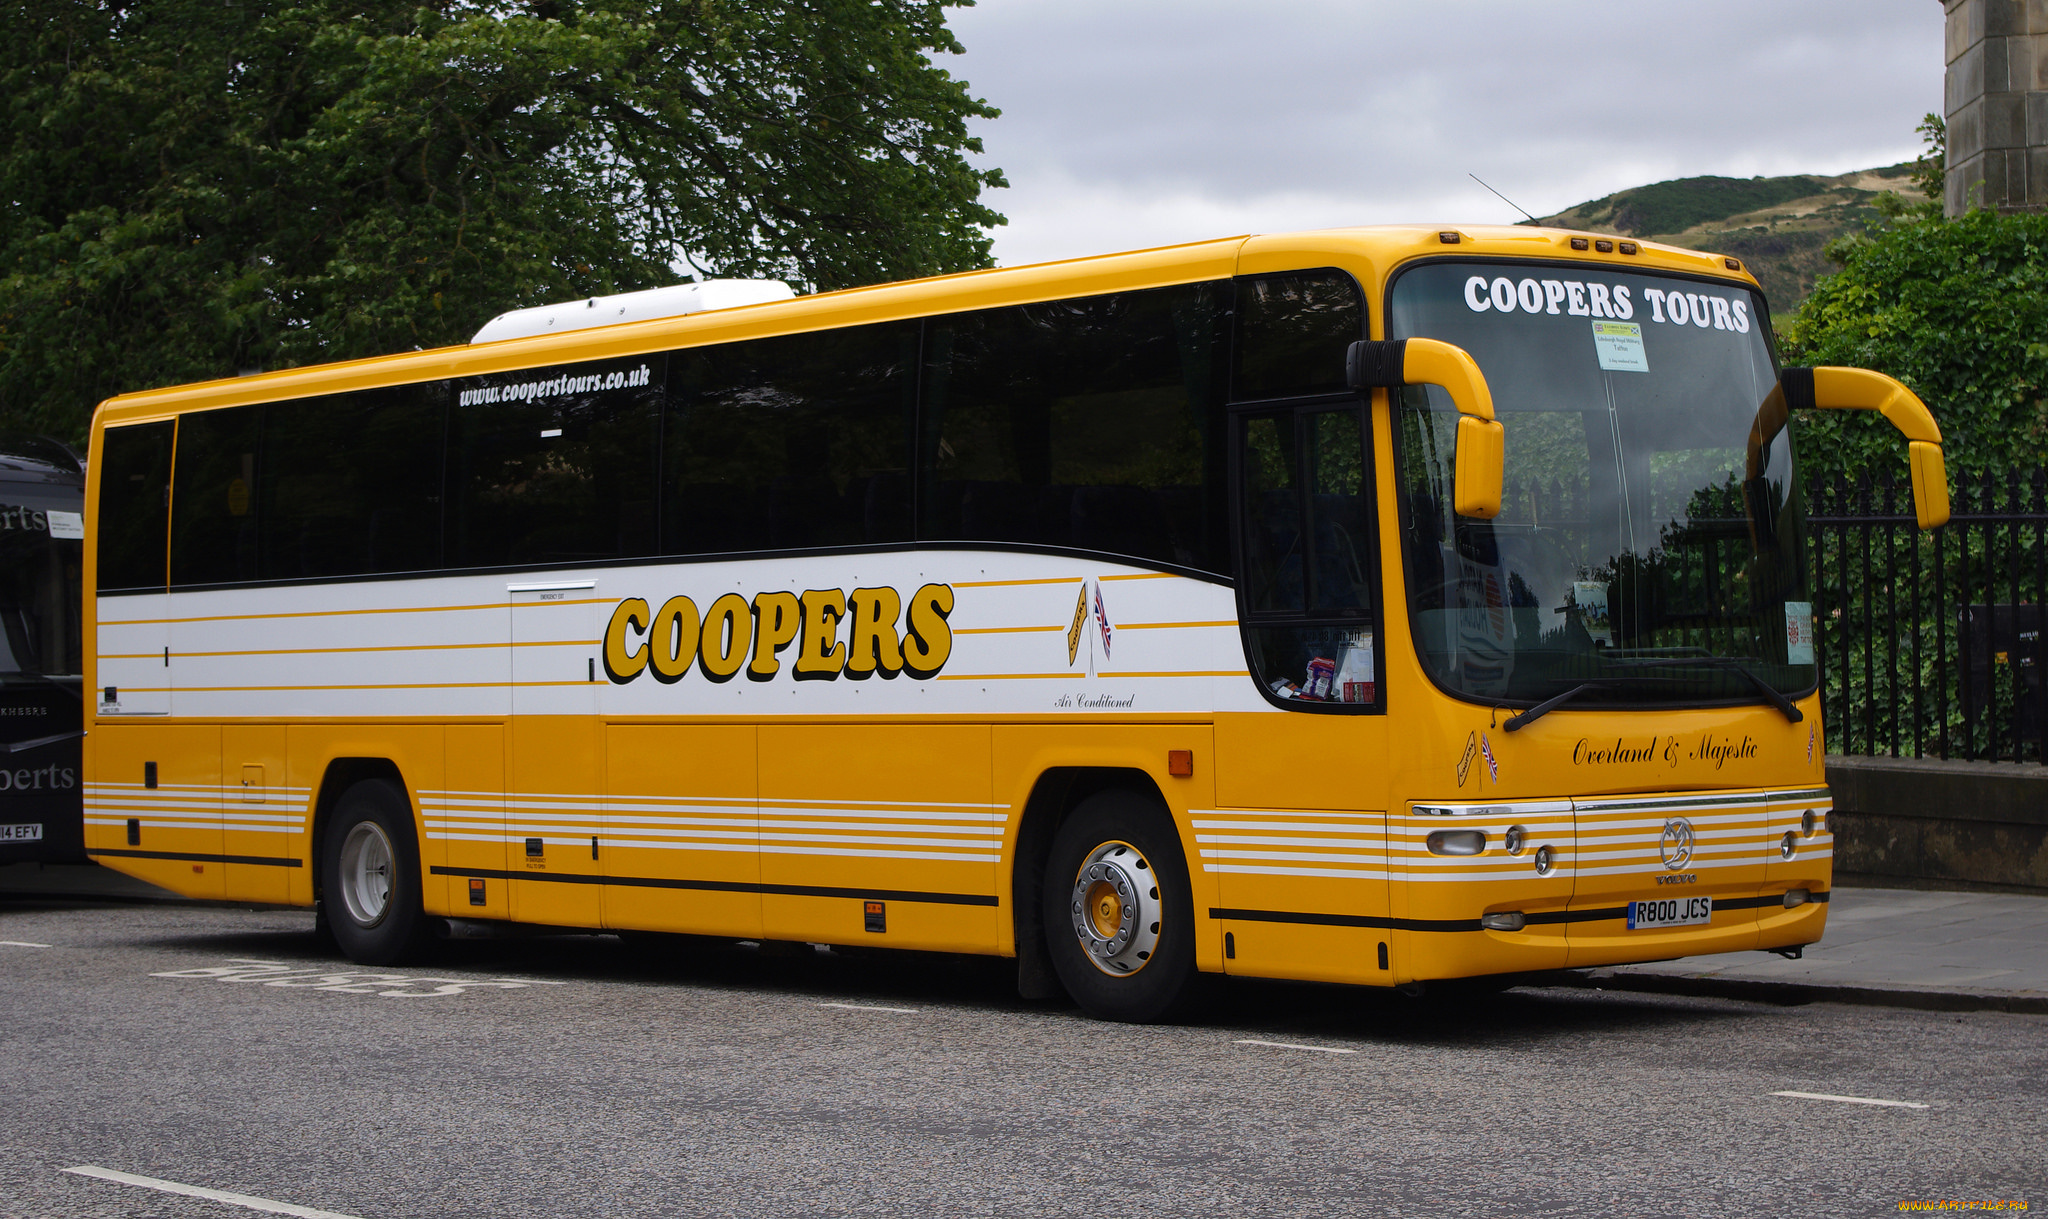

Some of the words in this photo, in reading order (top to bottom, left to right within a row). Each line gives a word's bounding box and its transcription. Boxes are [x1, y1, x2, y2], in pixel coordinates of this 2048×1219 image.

[1464, 276, 1633, 320] COOPERS
[1644, 288, 1750, 334] TOURS
[459, 364, 650, 407] www.cooperstours.co.uk
[0, 505, 48, 531] rts
[603, 583, 955, 685] COOPERS
[1054, 693, 1071, 708] Air
[1076, 692, 1135, 708] Conditioned
[1573, 736, 1657, 765] Overland
[1663, 736, 1679, 768] &
[1689, 734, 1757, 770] Majestic
[0, 826, 12, 839] 14
[15, 826, 38, 838] EFV
[1656, 874, 1697, 885] VOLVO
[1637, 900, 1677, 923] R800
[1681, 898, 1709, 920] JCS
